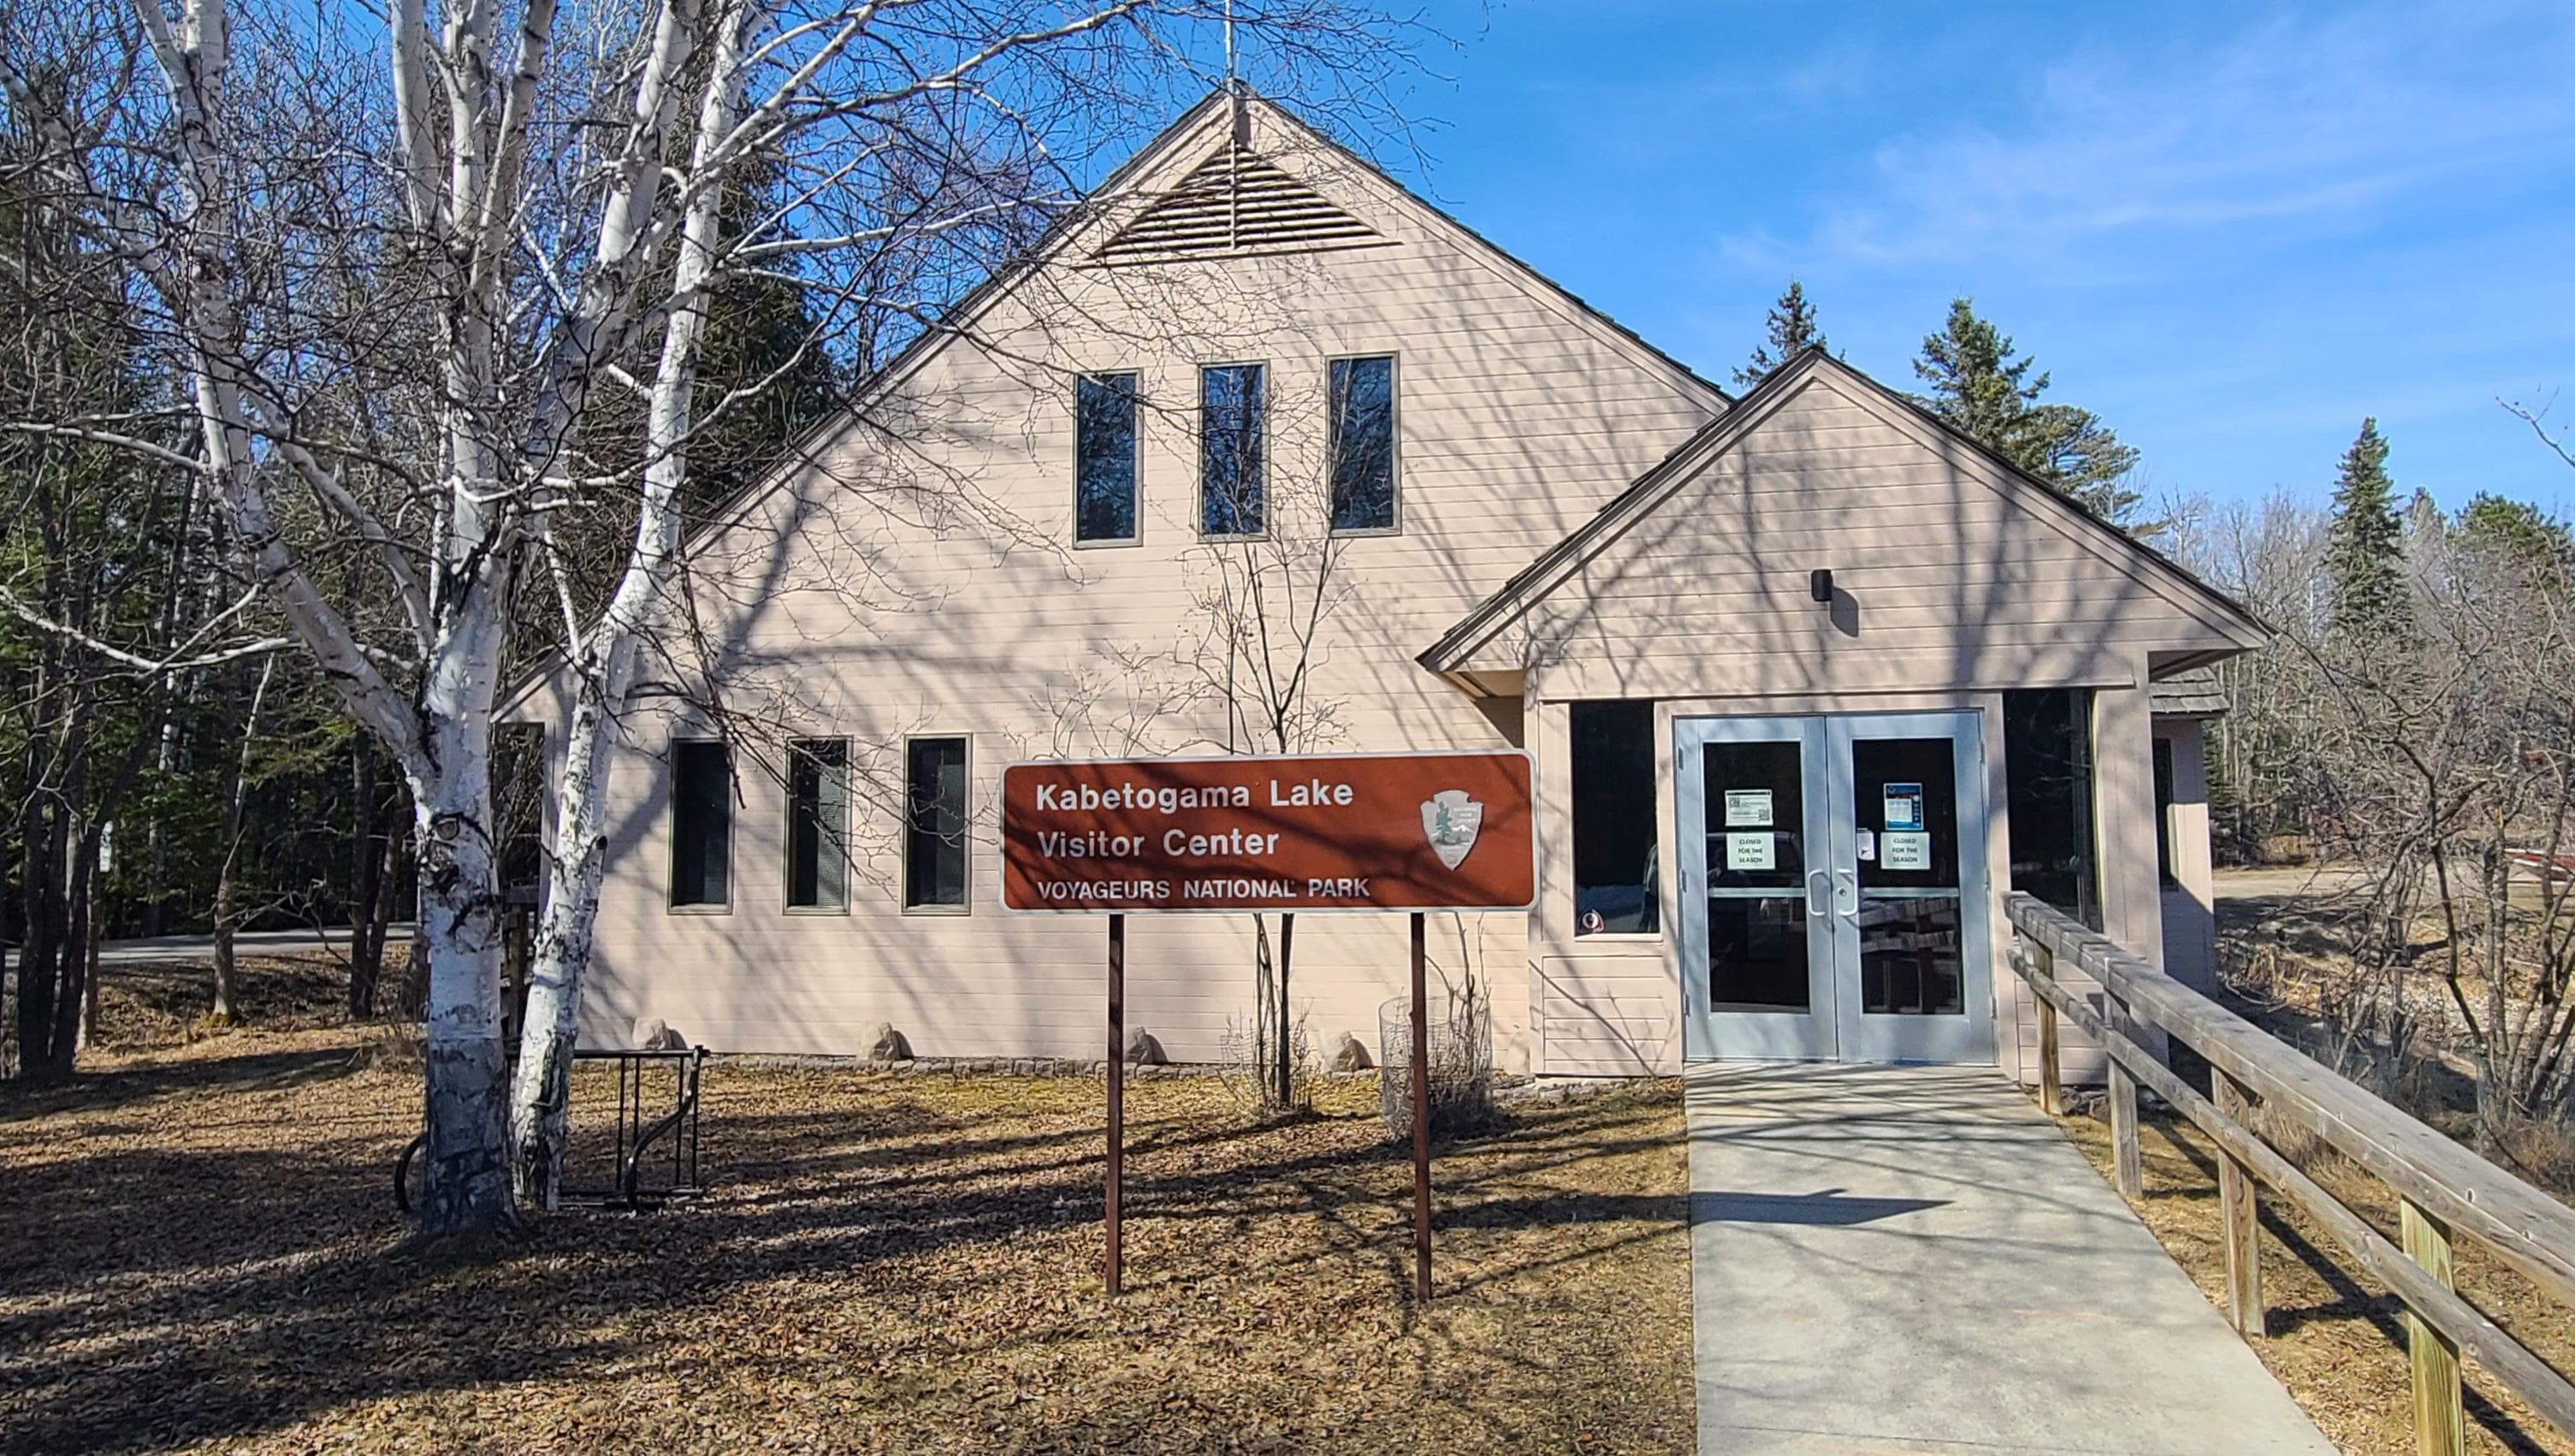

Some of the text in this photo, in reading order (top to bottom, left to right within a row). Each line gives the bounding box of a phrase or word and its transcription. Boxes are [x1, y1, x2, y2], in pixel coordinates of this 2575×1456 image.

[1036, 778, 1354, 814] Kabetogama Lake
[1037, 827, 1280, 858] Visitor Center
[1038, 878, 1370, 900] VOYAGEURS NATIONAL PARK
